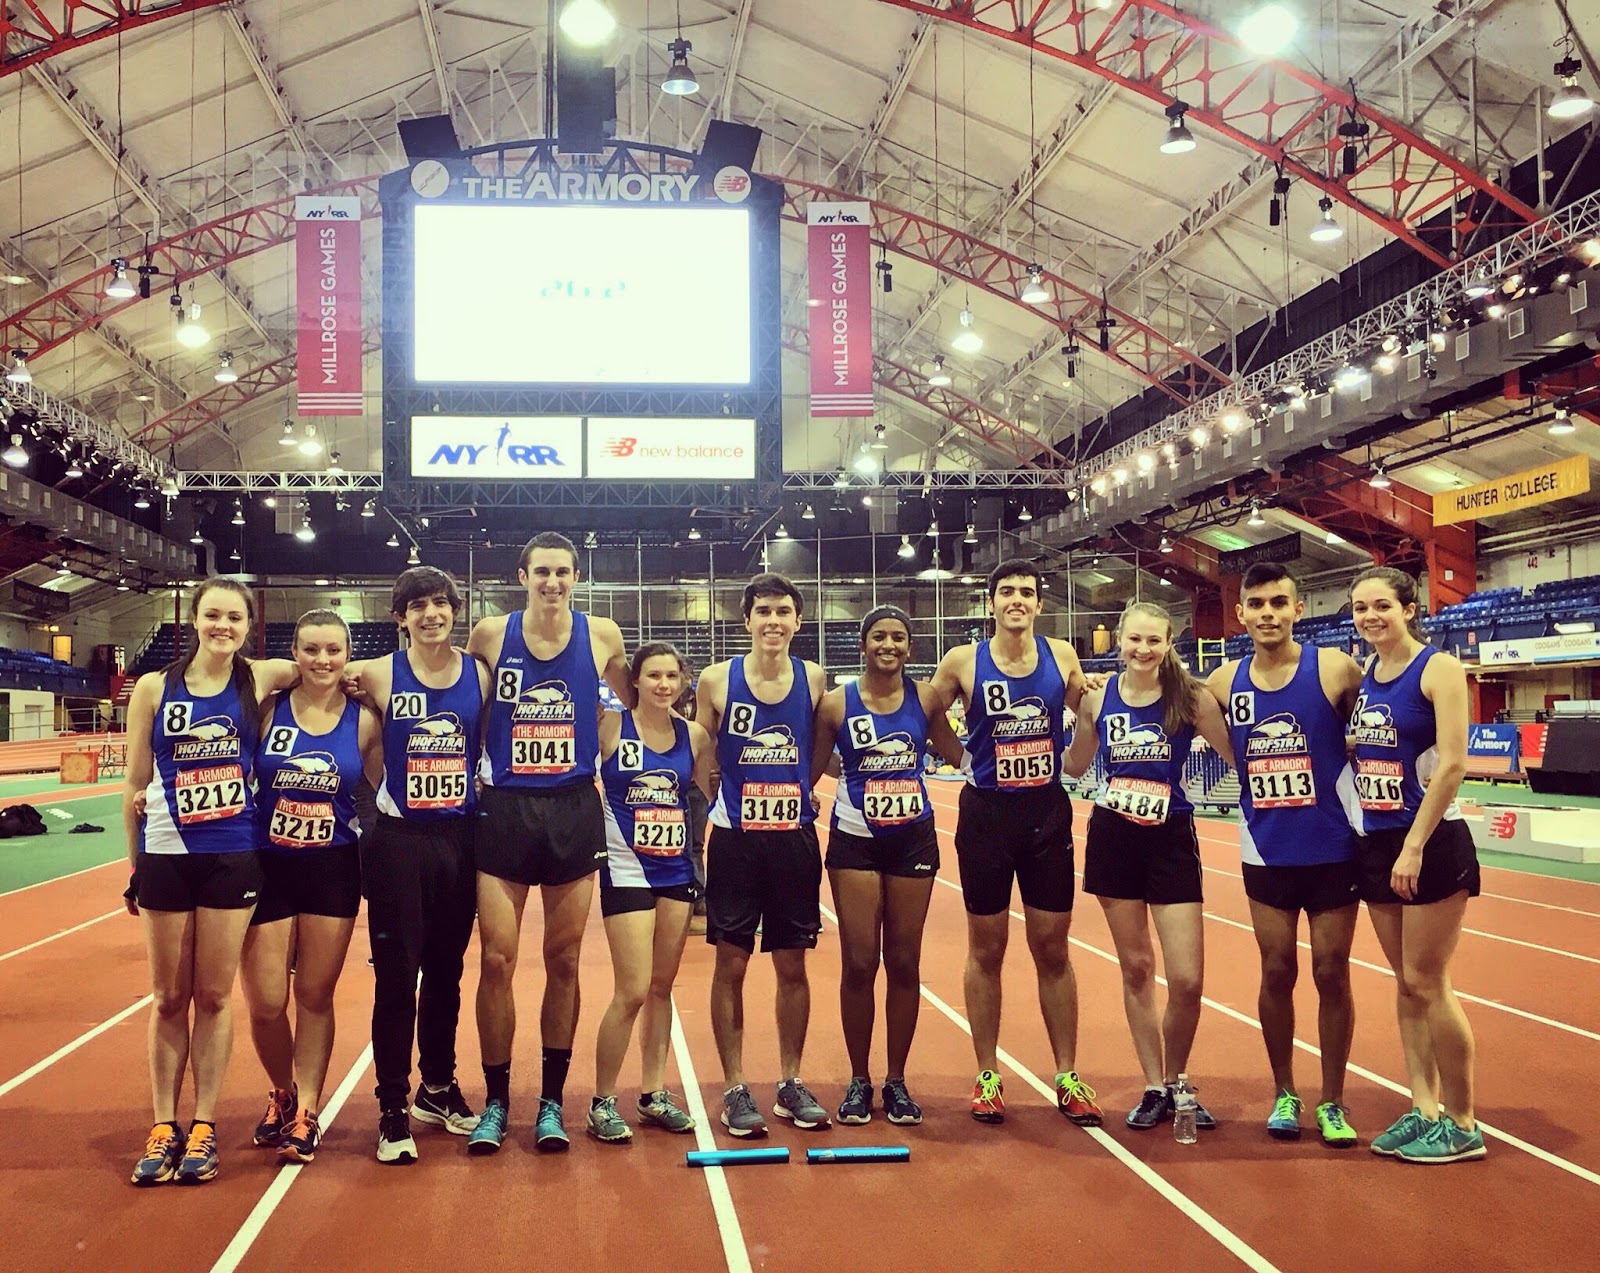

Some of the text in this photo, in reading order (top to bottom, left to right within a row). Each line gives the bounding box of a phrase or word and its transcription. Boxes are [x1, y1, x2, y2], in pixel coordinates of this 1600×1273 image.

[462, 172, 700, 201] THE ARMORY
[320, 227, 337, 384] MILLROSE GAMES
[831, 232, 848, 386] MILLROSE GAMES
[640, 447, 672, 457] new
[677, 444, 744, 458] balance
[1456, 472, 1557, 512] HUNTER COLLEGE
[499, 670, 518, 700] 8
[394, 695, 422, 718] 20
[517, 704, 572, 715] HOFSTRA
[987, 684, 1007, 712] 8
[1234, 694, 1251, 722] 8
[167, 704, 187, 733] 8
[733, 705, 752, 734] 8
[1352, 697, 1364, 726] 8
[516, 726, 571, 738] THE ARMORY
[852, 718, 872, 745] 8
[997, 719, 1048, 732] HOFSTRA
[1110, 715, 1126, 743] 8
[1482, 728, 1497, 739] The
[177, 740, 238, 754] HOFSTRA
[270, 728, 293, 753] 8
[411, 736, 463, 748] HOFSTRA
[999, 740, 1051, 756] THE ARMORY
[1113, 745, 1169, 757] HOFSTRA
[1251, 737, 1303, 749] HOFSTRA
[1474, 738, 1511, 752] Armory
[514, 741, 571, 764] 3041
[744, 748, 796, 759] HOFSTRA
[864, 754, 915, 766] HOFSTRA
[178, 766, 239, 786] THE ARMORY
[411, 759, 464, 772] THE ARMORY
[998, 754, 1052, 780] 3053
[1251, 758, 1307, 773] THE ARMORY
[278, 771, 338, 788] HOFSTRA
[409, 774, 465, 799] 3055
[868, 780, 918, 793] THE ARMORY
[1113, 778, 1167, 796] THE ARMORY
[1252, 772, 1312, 799] 3113
[178, 781, 244, 815] 3212
[744, 798, 798, 821] 3148
[866, 795, 922, 818] 3214
[272, 812, 333, 841] 3215
[637, 824, 685, 847] 3213
